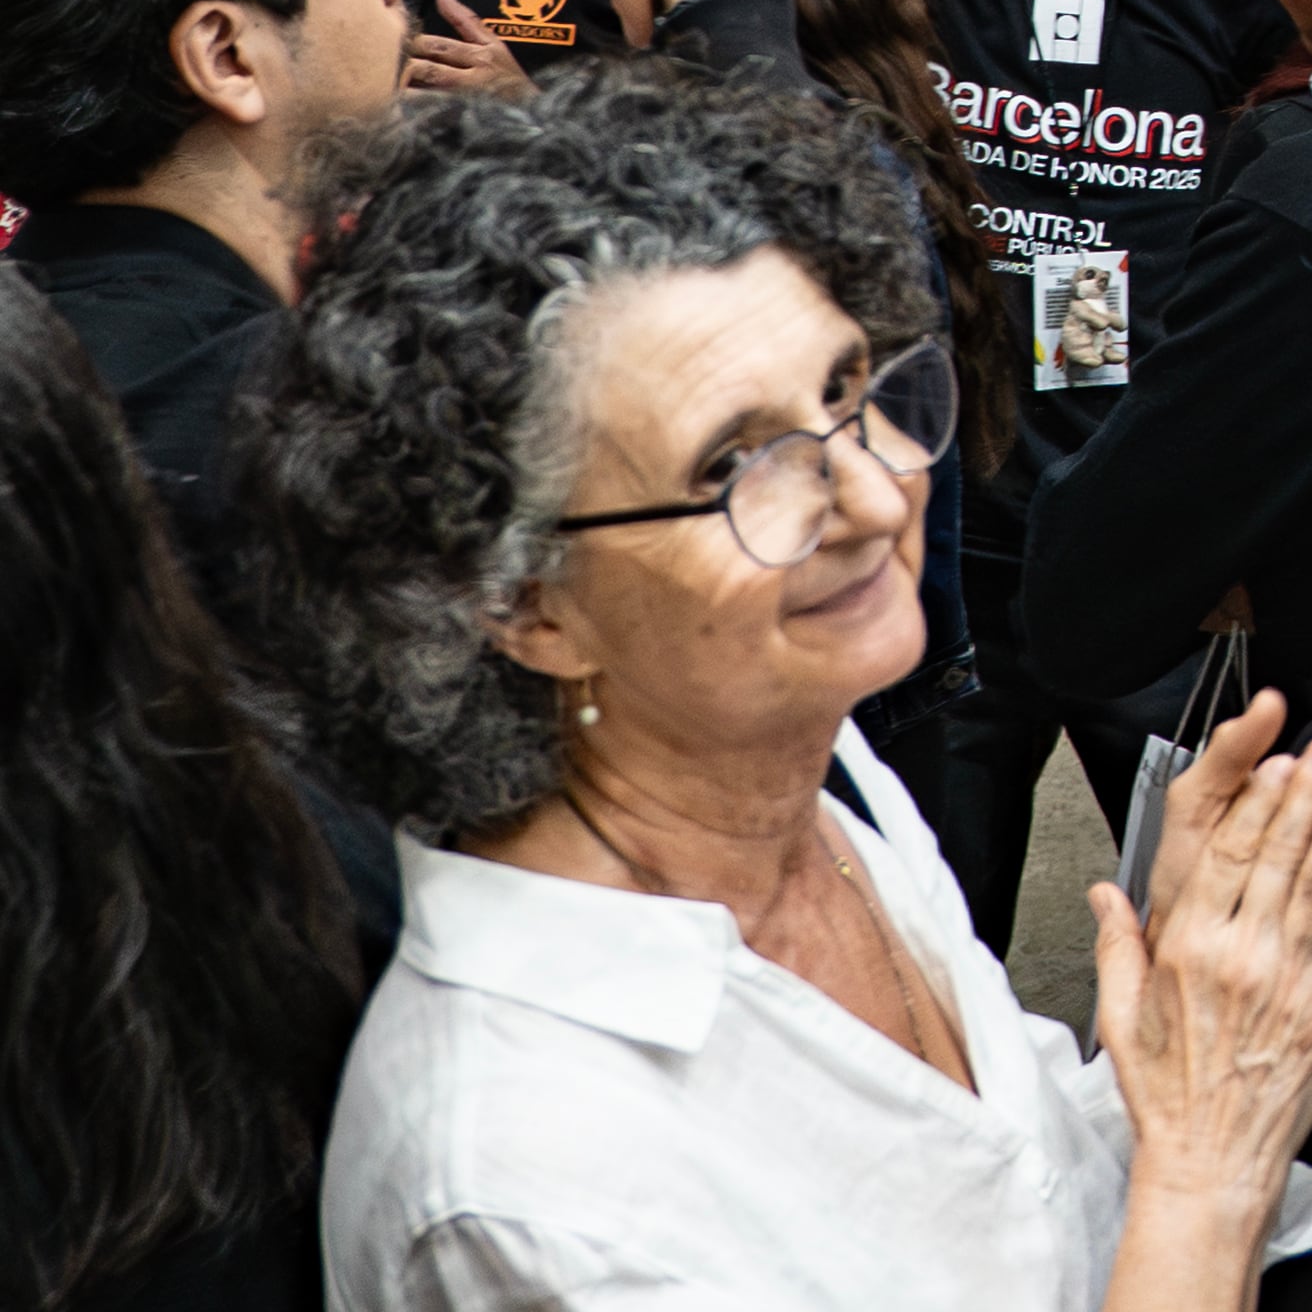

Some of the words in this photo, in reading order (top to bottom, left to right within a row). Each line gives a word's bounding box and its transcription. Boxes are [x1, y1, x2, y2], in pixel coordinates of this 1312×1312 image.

[490, 23, 566, 39] ONDORS
[1010, 149, 1049, 176] DE
[1050, 157, 1147, 189] HONOR
[1148, 167, 1203, 190] 2025
[967, 202, 1113, 248] CONTROL
